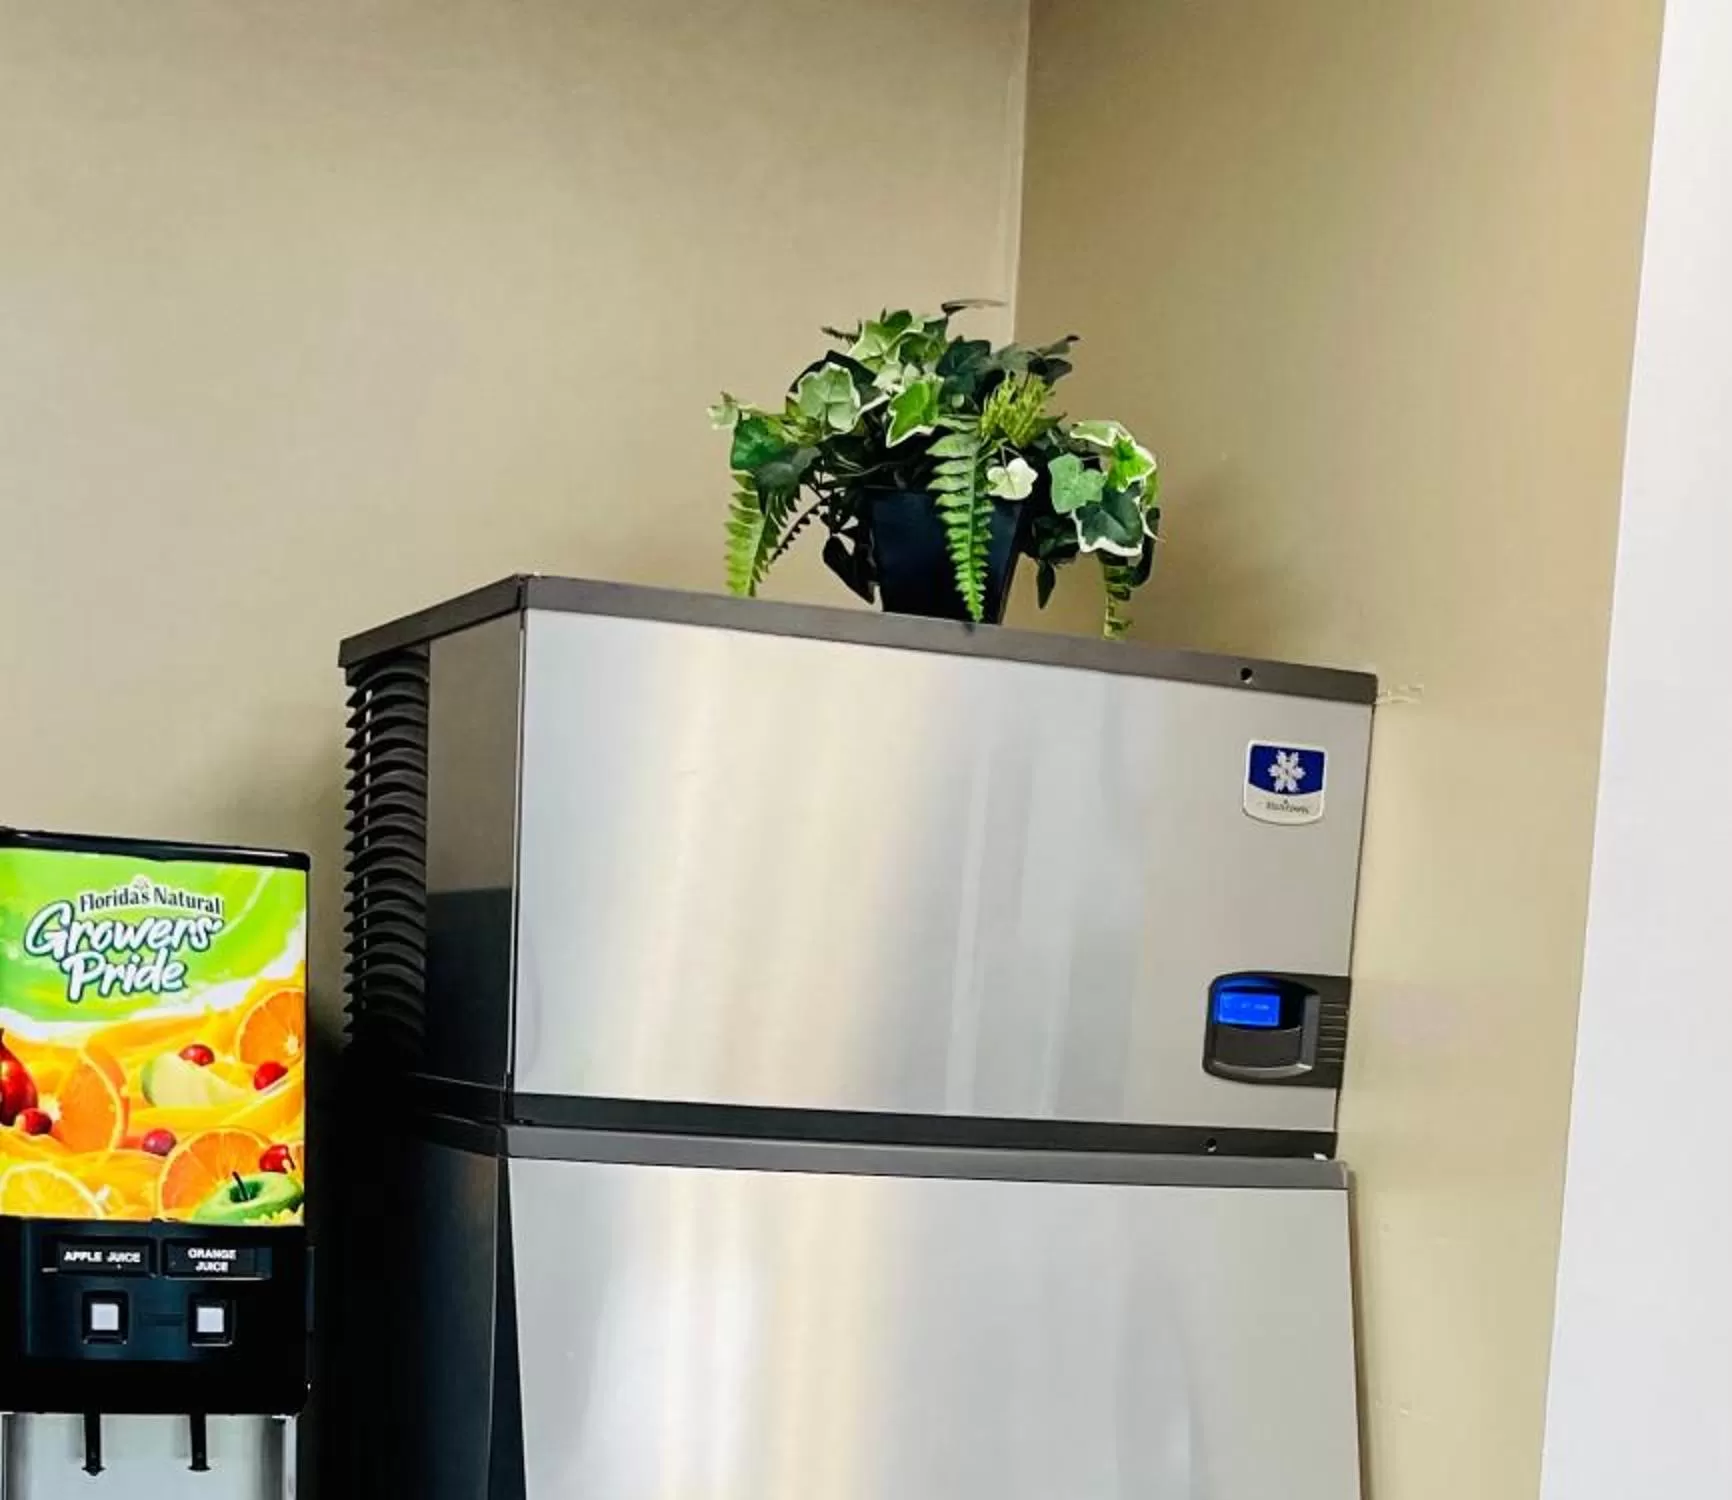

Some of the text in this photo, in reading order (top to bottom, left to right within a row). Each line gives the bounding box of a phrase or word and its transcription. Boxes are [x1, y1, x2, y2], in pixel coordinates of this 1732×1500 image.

[153, 886, 220, 915] Natural
[60, 948, 187, 1003] Pride
[64, 1250, 141, 1263] APPLE JUICE
[187, 1247, 236, 1260] ORANGE
[195, 1260, 229, 1272] JUICE
